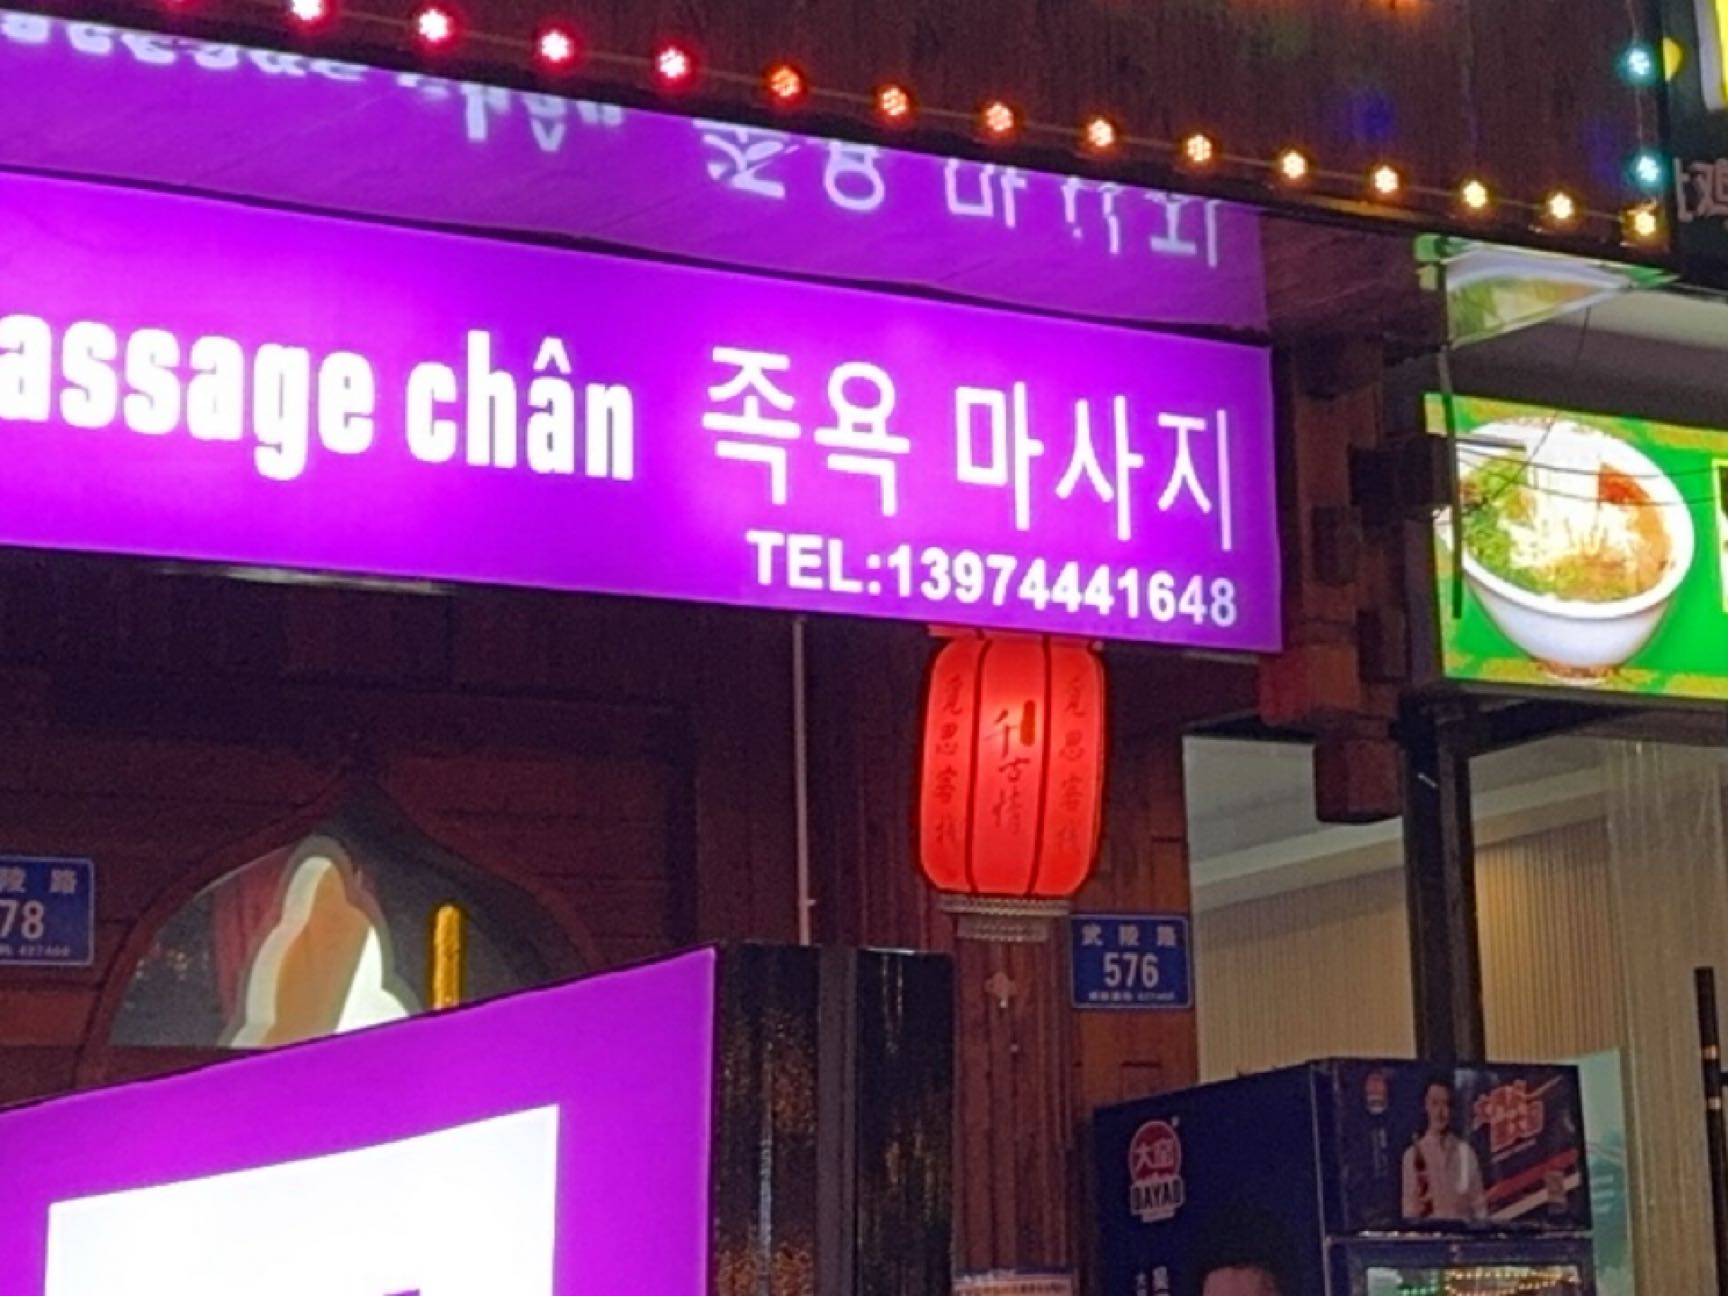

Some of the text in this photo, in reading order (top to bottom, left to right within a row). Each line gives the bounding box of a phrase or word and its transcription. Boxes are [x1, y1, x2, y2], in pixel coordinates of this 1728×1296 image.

[406, 330, 634, 481] chân
[703, 347, 1234, 552] 족욕 마사지
[745, 528, 1239, 628] TEL:13974441648
[1103, 951, 1159, 988] 576
